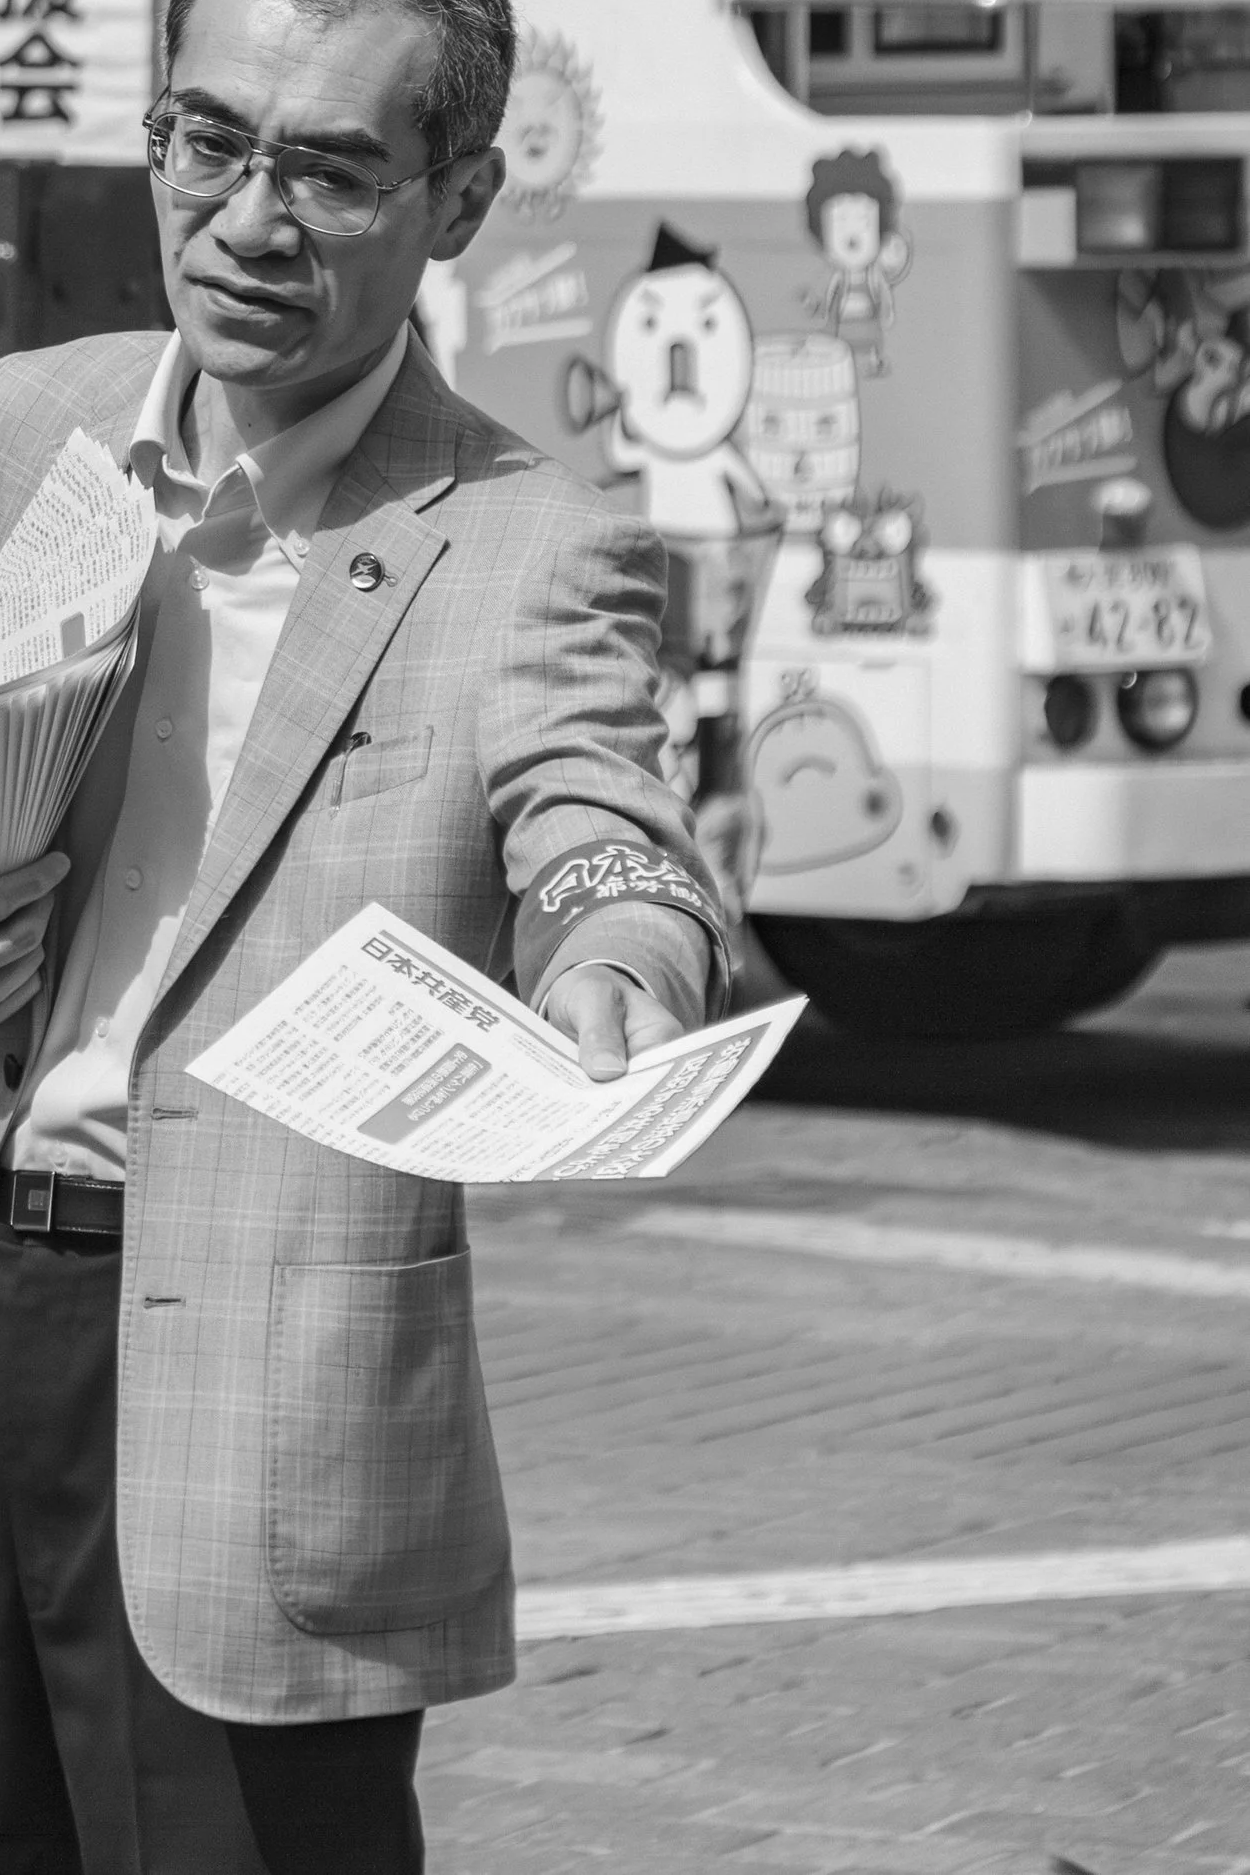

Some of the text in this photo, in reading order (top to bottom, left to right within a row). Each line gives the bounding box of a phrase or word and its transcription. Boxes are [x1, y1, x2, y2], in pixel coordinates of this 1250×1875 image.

[360, 937, 501, 1034] 日本共産党
